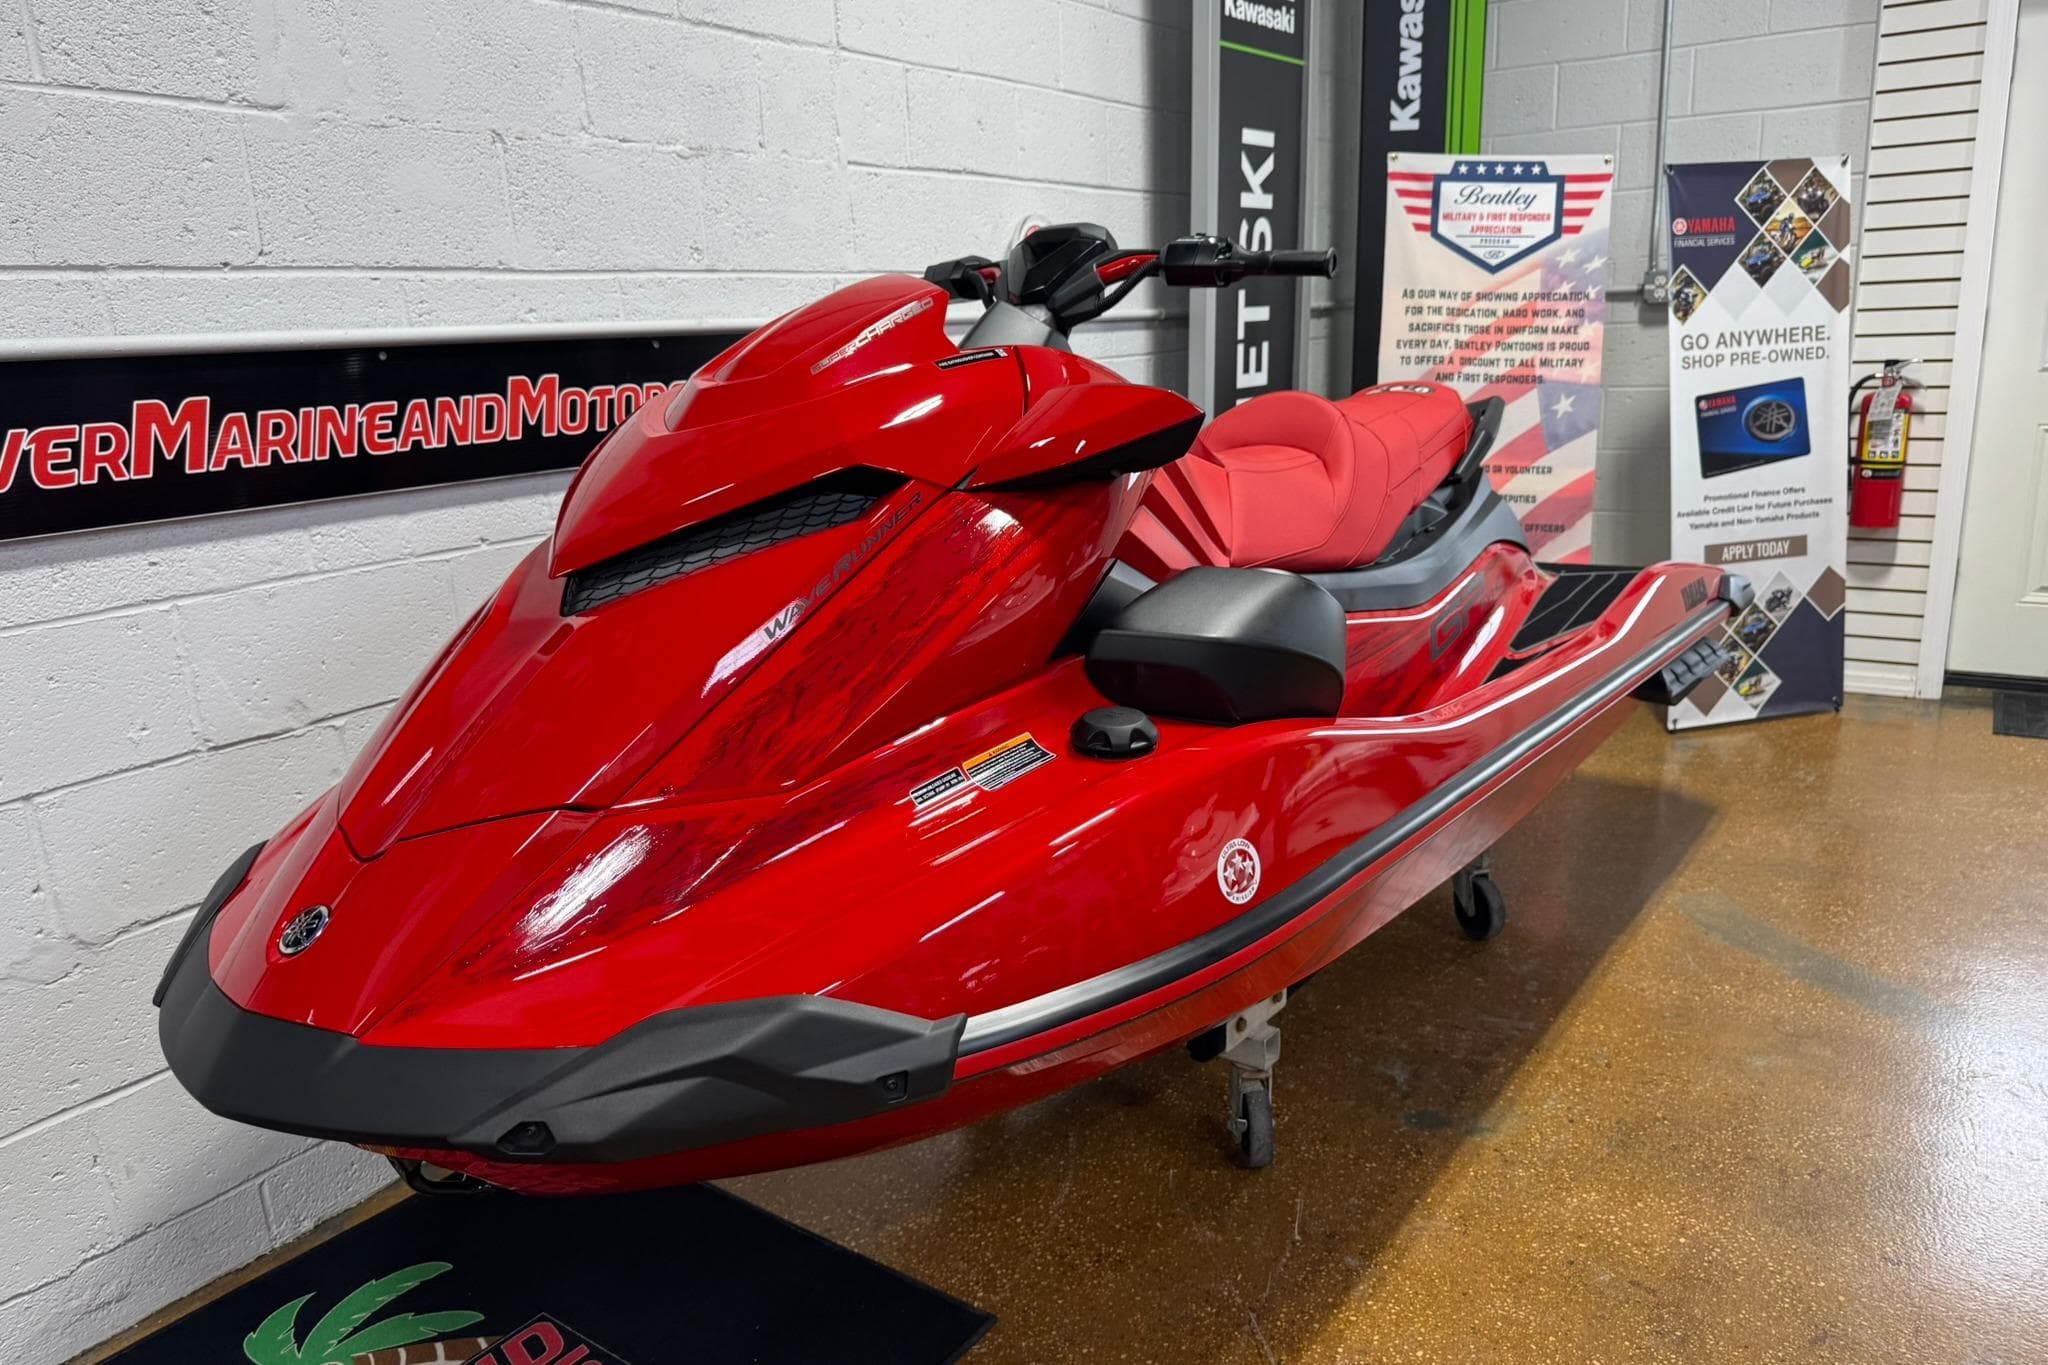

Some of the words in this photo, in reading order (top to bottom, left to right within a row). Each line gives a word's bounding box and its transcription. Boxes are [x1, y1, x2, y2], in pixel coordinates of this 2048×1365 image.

[1225, 0, 1295, 34] Kawasaki
[1239, 127, 1276, 253] SKI
[1454, 184, 1537, 211] Bentley
[1442, 212, 1477, 222] MILITARY
[1487, 212, 1507, 222] FIRST
[1509, 212, 1551, 222] RESPONDER
[1687, 216, 1736, 234] YAMAHA
[1469, 224, 1522, 234] APPRECIATION
[1673, 237, 1705, 248] FINANCIAL
[1706, 236, 1735, 247] SERVICES
[1418, 289, 1436, 299] OUR
[1439, 289, 1457, 301] WAY
[1461, 290, 1472, 301] OF
[1475, 291, 1518, 302] SHOWING
[1521, 292, 1590, 302] APPRECIATION
[1405, 306, 1423, 317] FOR
[1427, 306, 1443, 317] THE
[1503, 308, 1528, 319] HARD
[1565, 308, 1585, 319] AND
[810, 297, 934, 375] SUPERCHARGED
[1408, 323, 1460, 333] SACRIFICES
[1464, 324, 1491, 335] THOSE
[1494, 325, 1503, 335] IN
[1506, 325, 1548, 335] UNIFORM
[1551, 325, 1579, 335] MAKE
[1396, 339, 1427, 350] EVERY
[1495, 341, 1543, 352] PONTOONS
[1547, 342, 1556, 351] IS
[1559, 342, 1590, 351] PROUD
[1681, 333, 1709, 351] GO
[1715, 325, 1831, 349] ANYWHERE.
[1236, 288, 1271, 406] ET
[1400, 356, 1411, 366] TO
[1414, 356, 1445, 366] OFFER
[1448, 357, 1454, 366] A
[1459, 357, 1501, 367] DISCOUNT
[1504, 358, 1515, 368] TO
[1518, 358, 1535, 368] ALL
[1539, 358, 1584, 368] MILITARY
[1681, 353, 1725, 370] SHOP
[1730, 346, 1830, 367] PRE-OWNED.
[1435, 373, 1454, 382] AND
[1505, 466, 1552, 475] VOLUNTEER
[1704, 491, 1749, 502] Promotional
[1751, 488, 1780, 498] Finance
[1783, 486, 1806, 495] Offers
[1677, 508, 1710, 518] Available
[1712, 506, 1735, 516] Credit
[1737, 503, 1752, 512] Line
[1755, 502, 1765, 511] for
[1767, 500, 1793, 510] Future
[1794, 497, 1833, 507] Purchases
[1524, 523, 1566, 533] OFFICERS
[1689, 520, 1719, 530] Yamaha
[1721, 518, 1735, 528] and
[1786, 511, 1820, 521] Products
[1722, 545, 1754, 561] APPLY
[1757, 540, 1790, 556] TODAY
